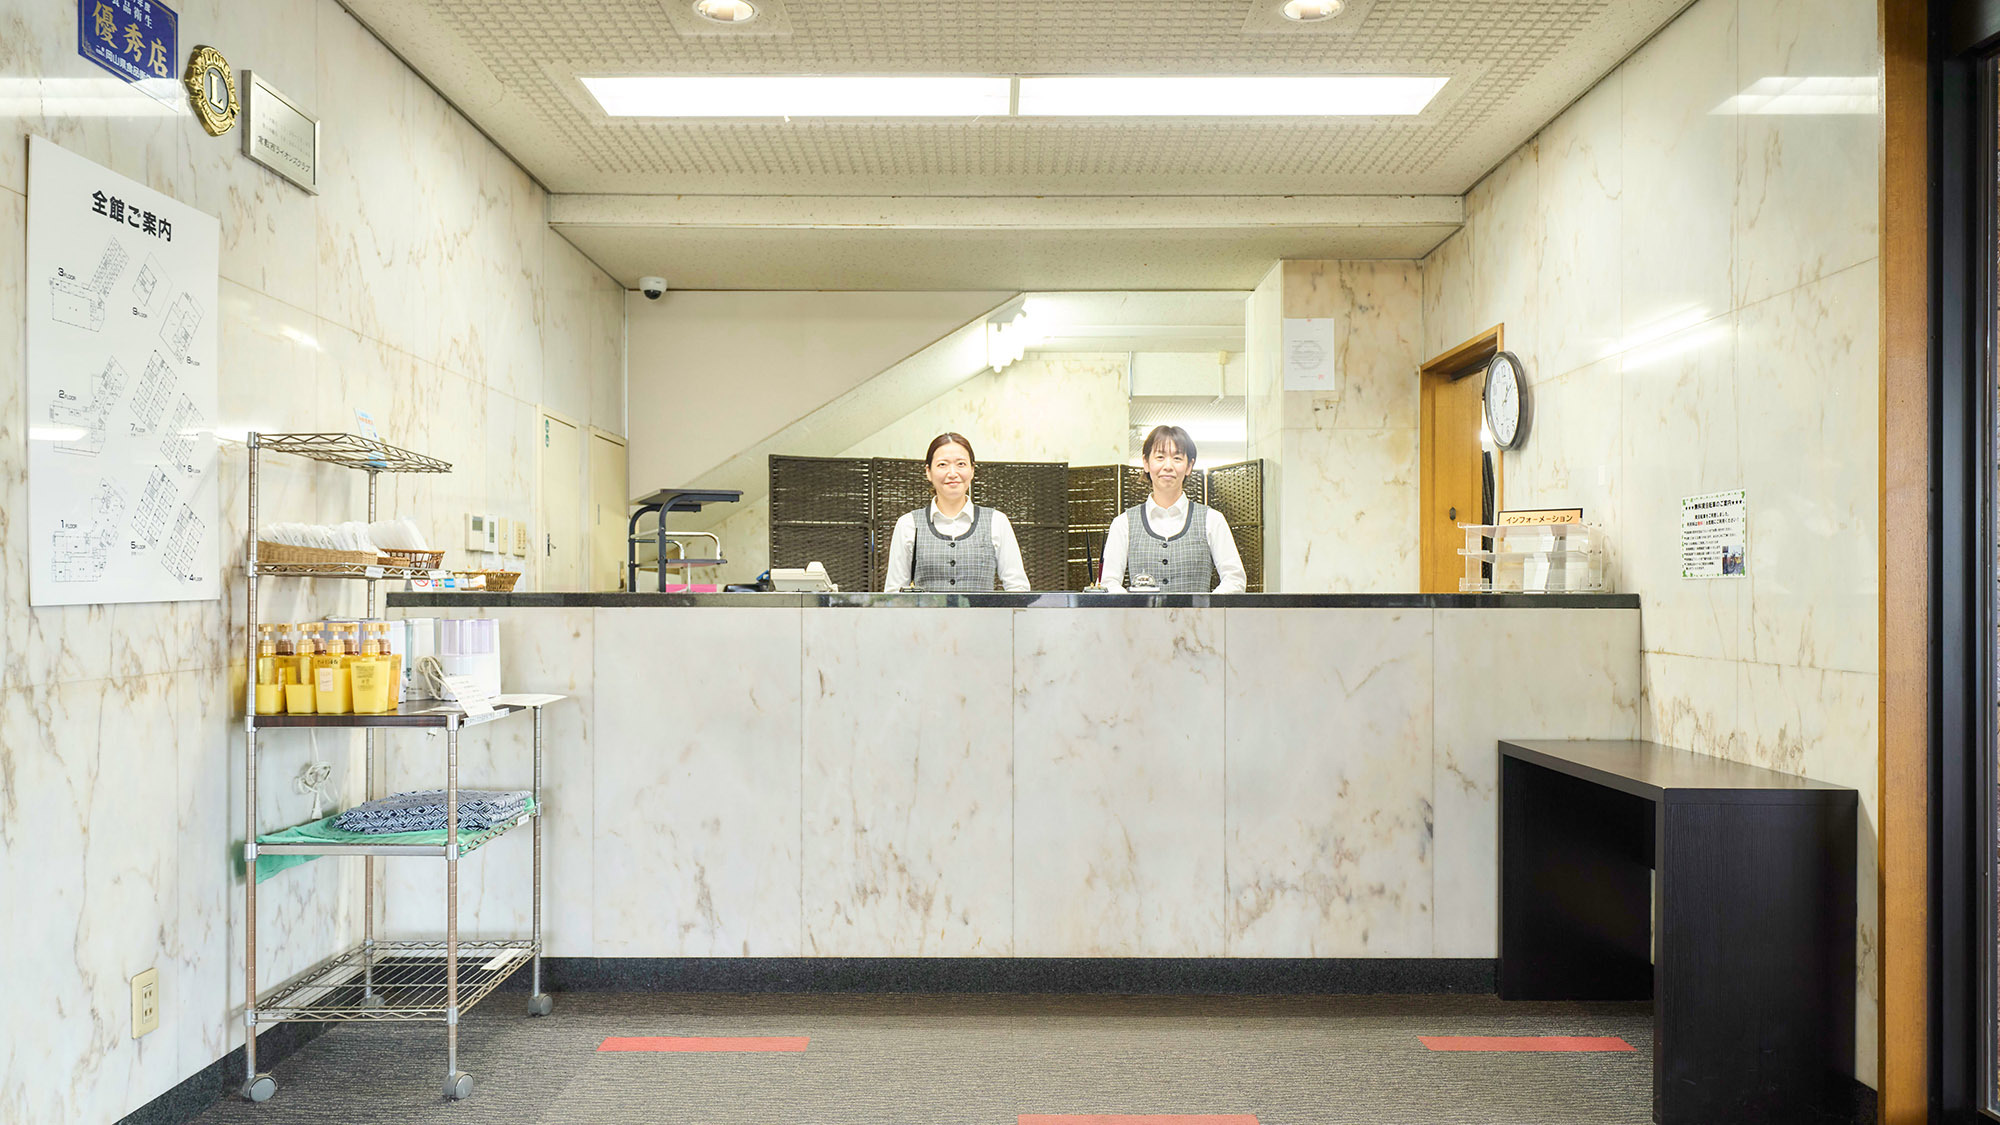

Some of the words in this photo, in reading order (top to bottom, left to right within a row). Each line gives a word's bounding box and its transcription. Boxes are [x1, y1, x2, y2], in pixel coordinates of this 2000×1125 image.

[92, 1, 168, 78] 優秀店
[209, 72, 224, 111] L
[92, 190, 172, 242] 全館ご案内
[1506, 515, 1573, 525] インフォーメーション
